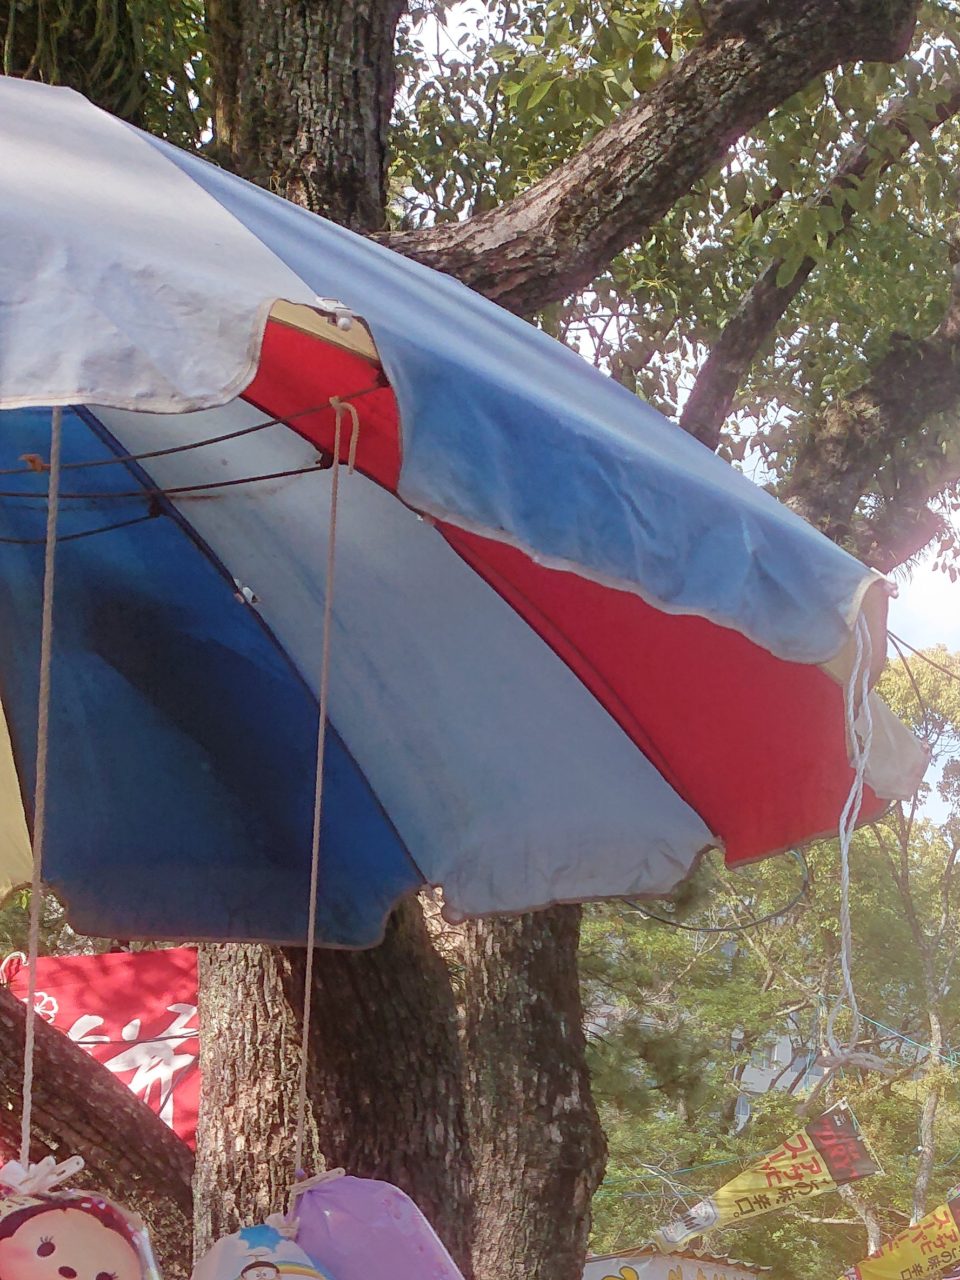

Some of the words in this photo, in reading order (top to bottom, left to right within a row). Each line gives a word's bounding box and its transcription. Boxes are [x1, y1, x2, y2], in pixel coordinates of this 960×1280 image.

[766, 1156, 822, 1188] アサヒ
[919, 1229, 959, 1255] アサヒ
